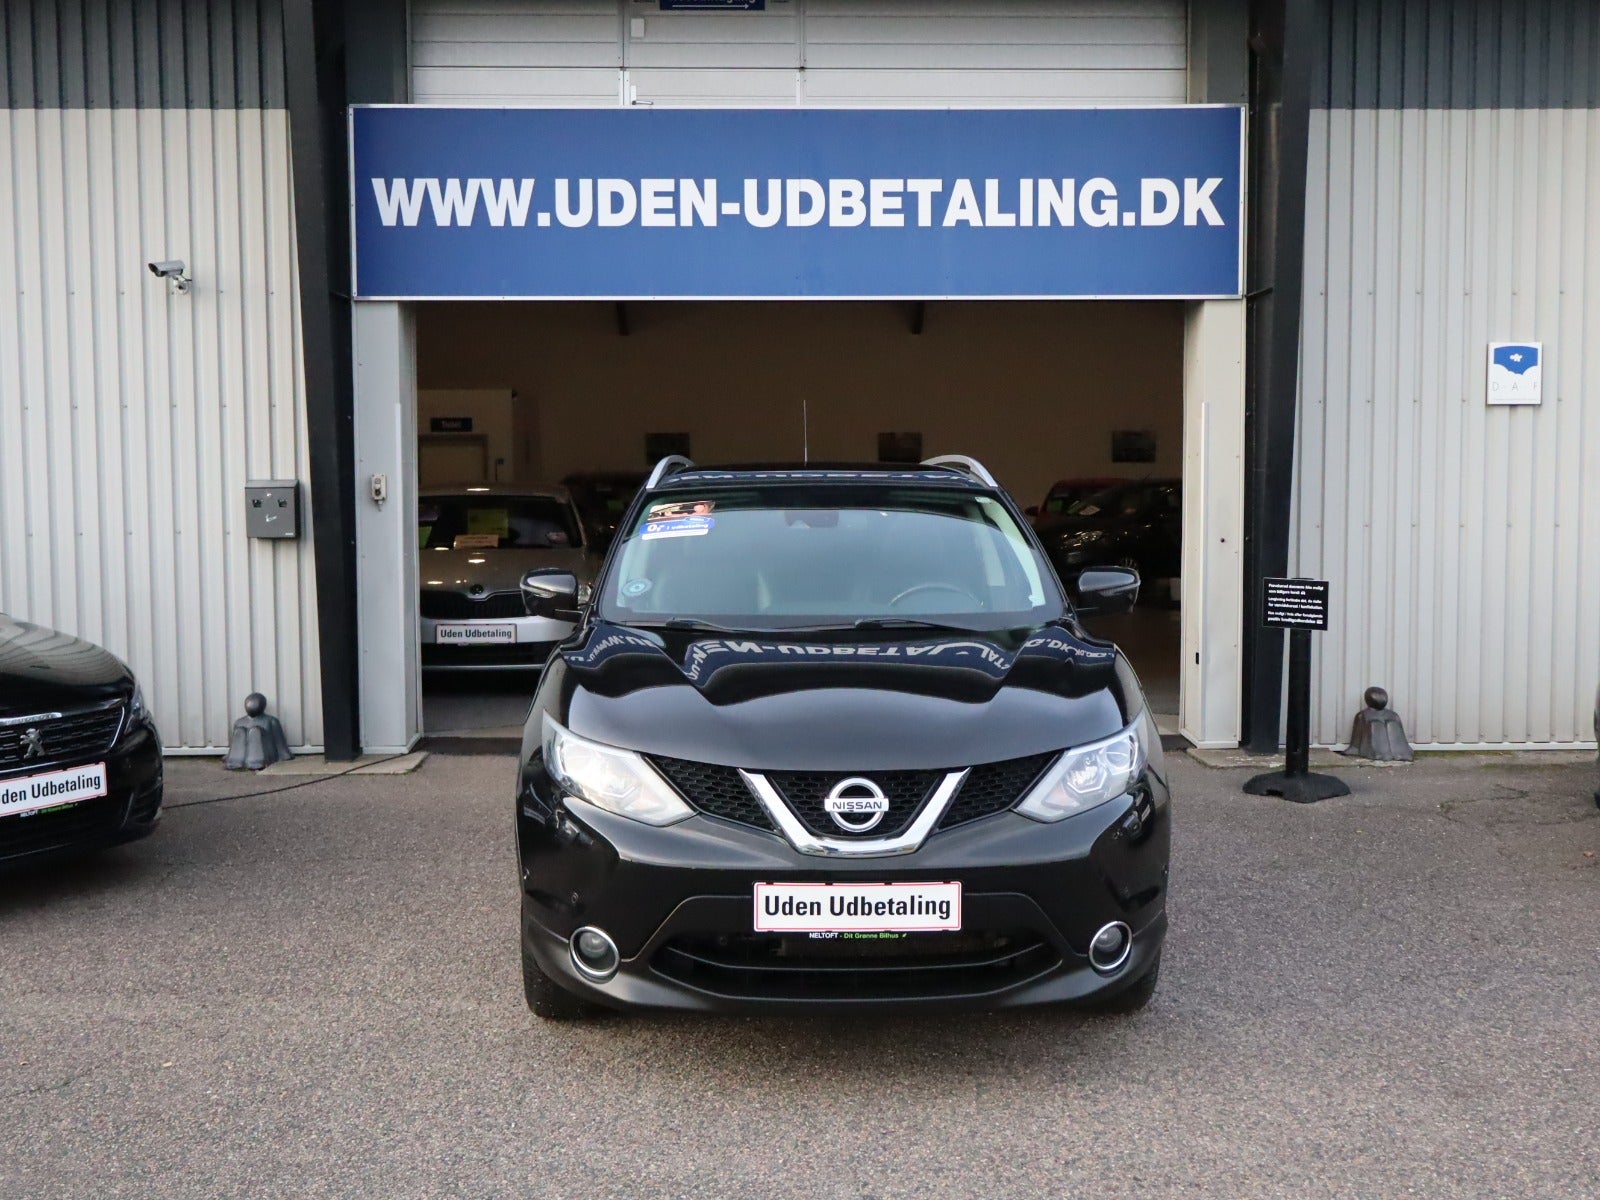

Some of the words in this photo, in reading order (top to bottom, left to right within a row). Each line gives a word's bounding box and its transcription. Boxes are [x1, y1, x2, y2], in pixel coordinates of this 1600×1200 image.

[371, 177, 1225, 227] WWW.UDEN-UDBETALING.DK
[441, 629, 463, 638] Uden
[465, 628, 512, 639] Udbetaling
[1, 789, 27, 804] den
[31, 775, 101, 799] Udbetaling
[832, 801, 882, 810] NISSAN
[764, 895, 822, 916] Uden
[829, 894, 951, 920] Udbetaling
